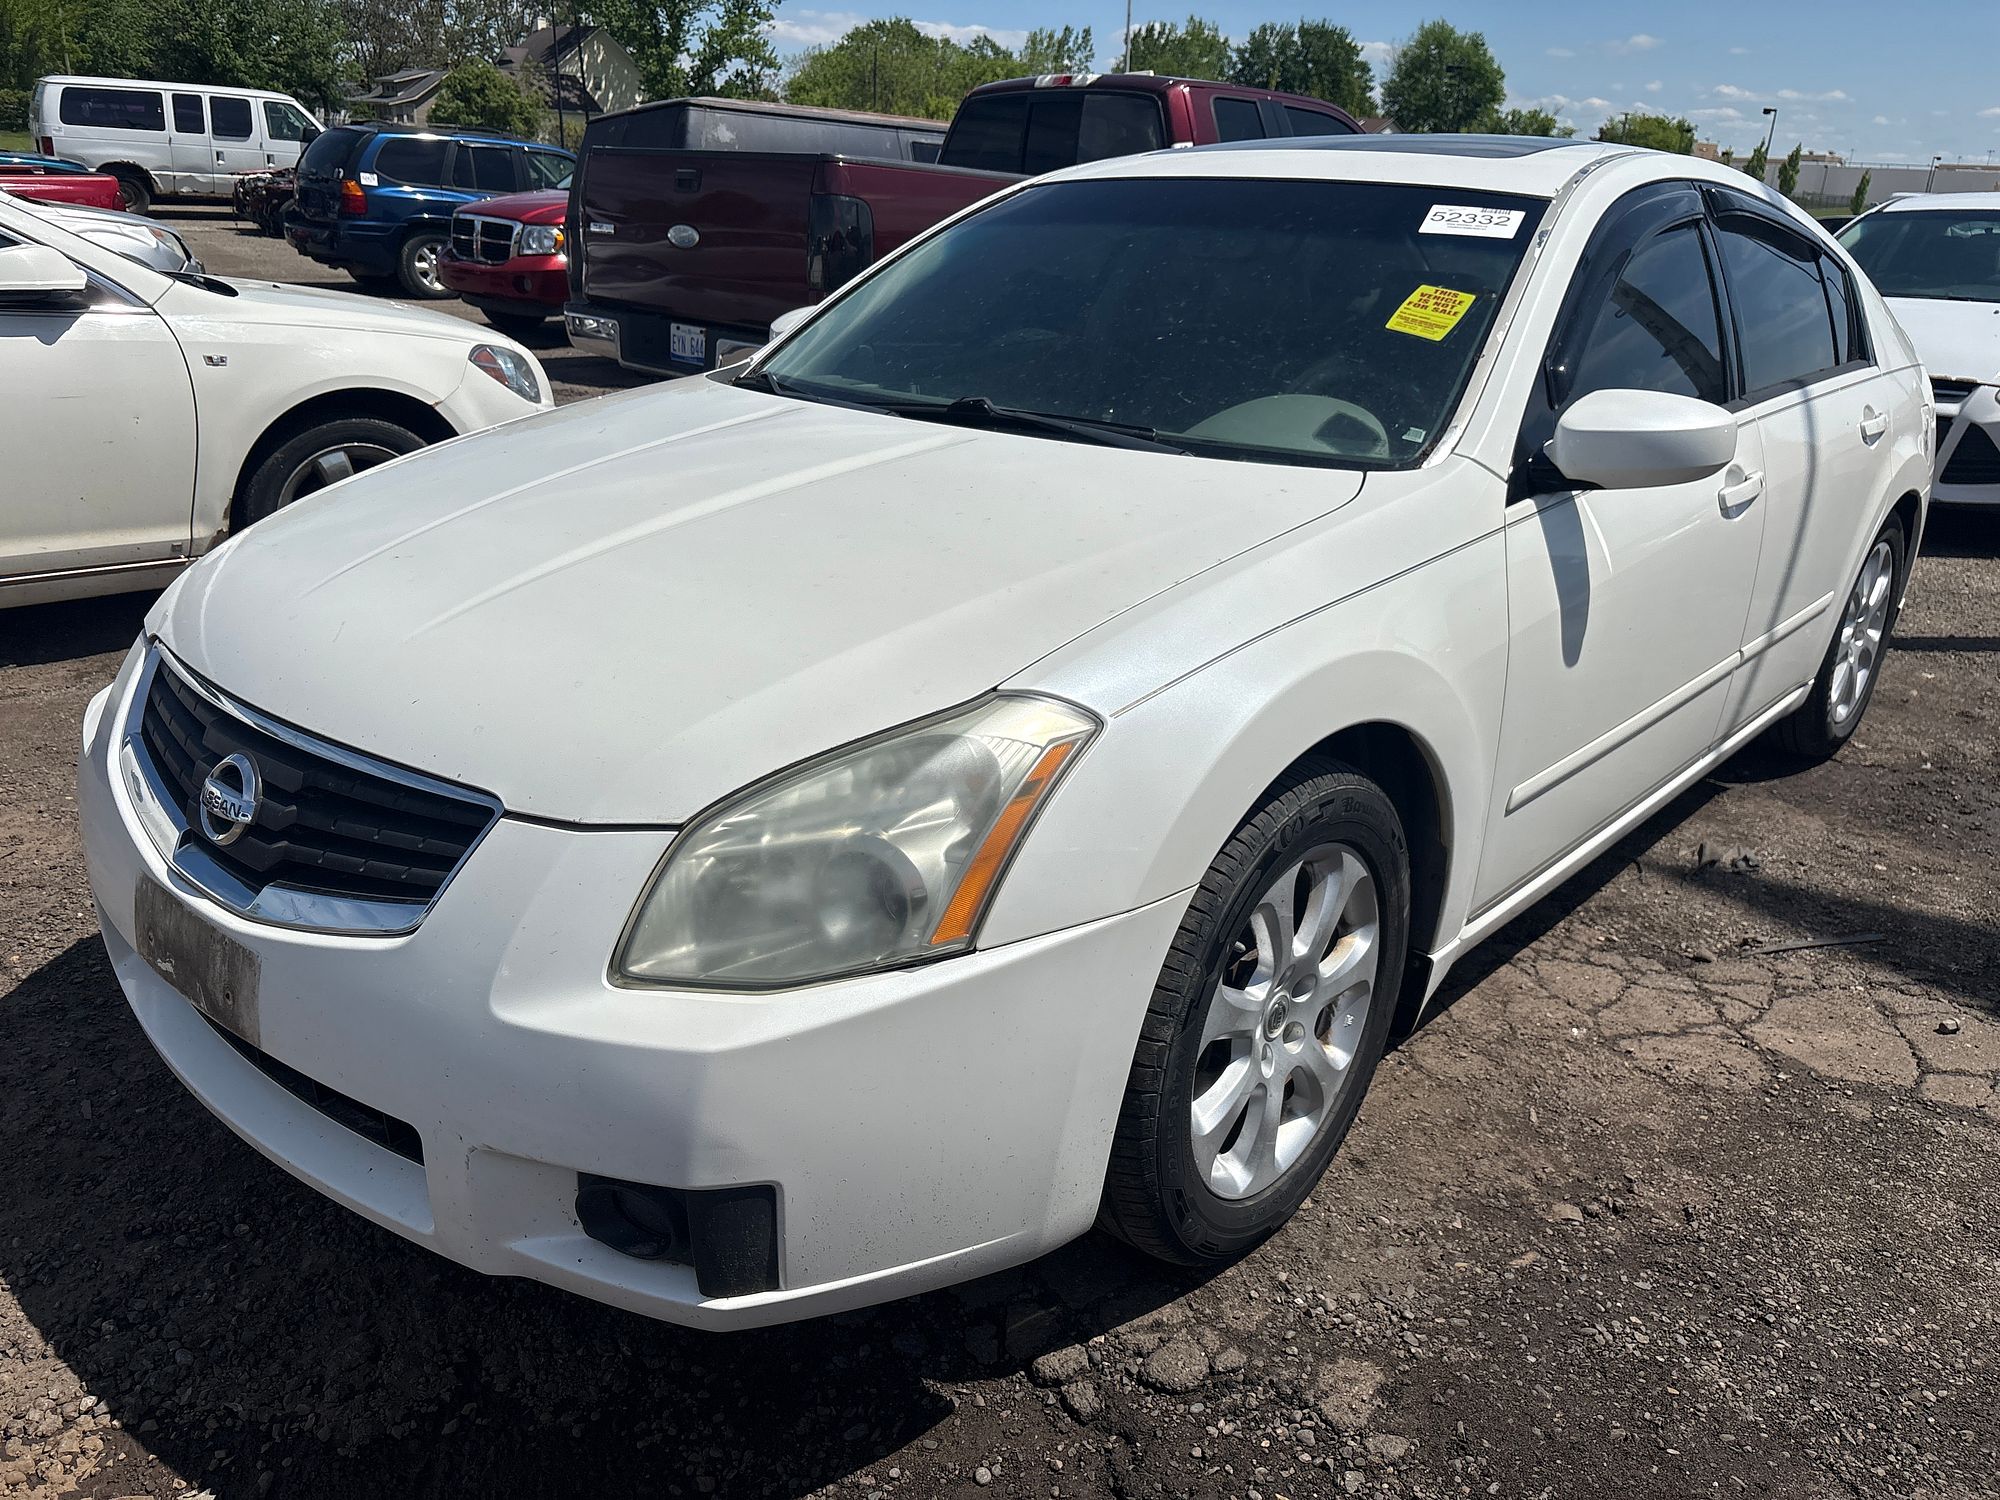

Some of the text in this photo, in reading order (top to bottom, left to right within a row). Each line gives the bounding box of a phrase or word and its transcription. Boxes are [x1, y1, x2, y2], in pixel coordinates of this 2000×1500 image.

[1430, 211, 1511, 226] 52332
[1419, 292, 1465, 306] VEHICLE
[1433, 289, 1460, 299] THIS
[1406, 301, 1462, 317] FOR SALE
[1432, 301, 1459, 310] NOT
[672, 333, 704, 357] EYN 644
